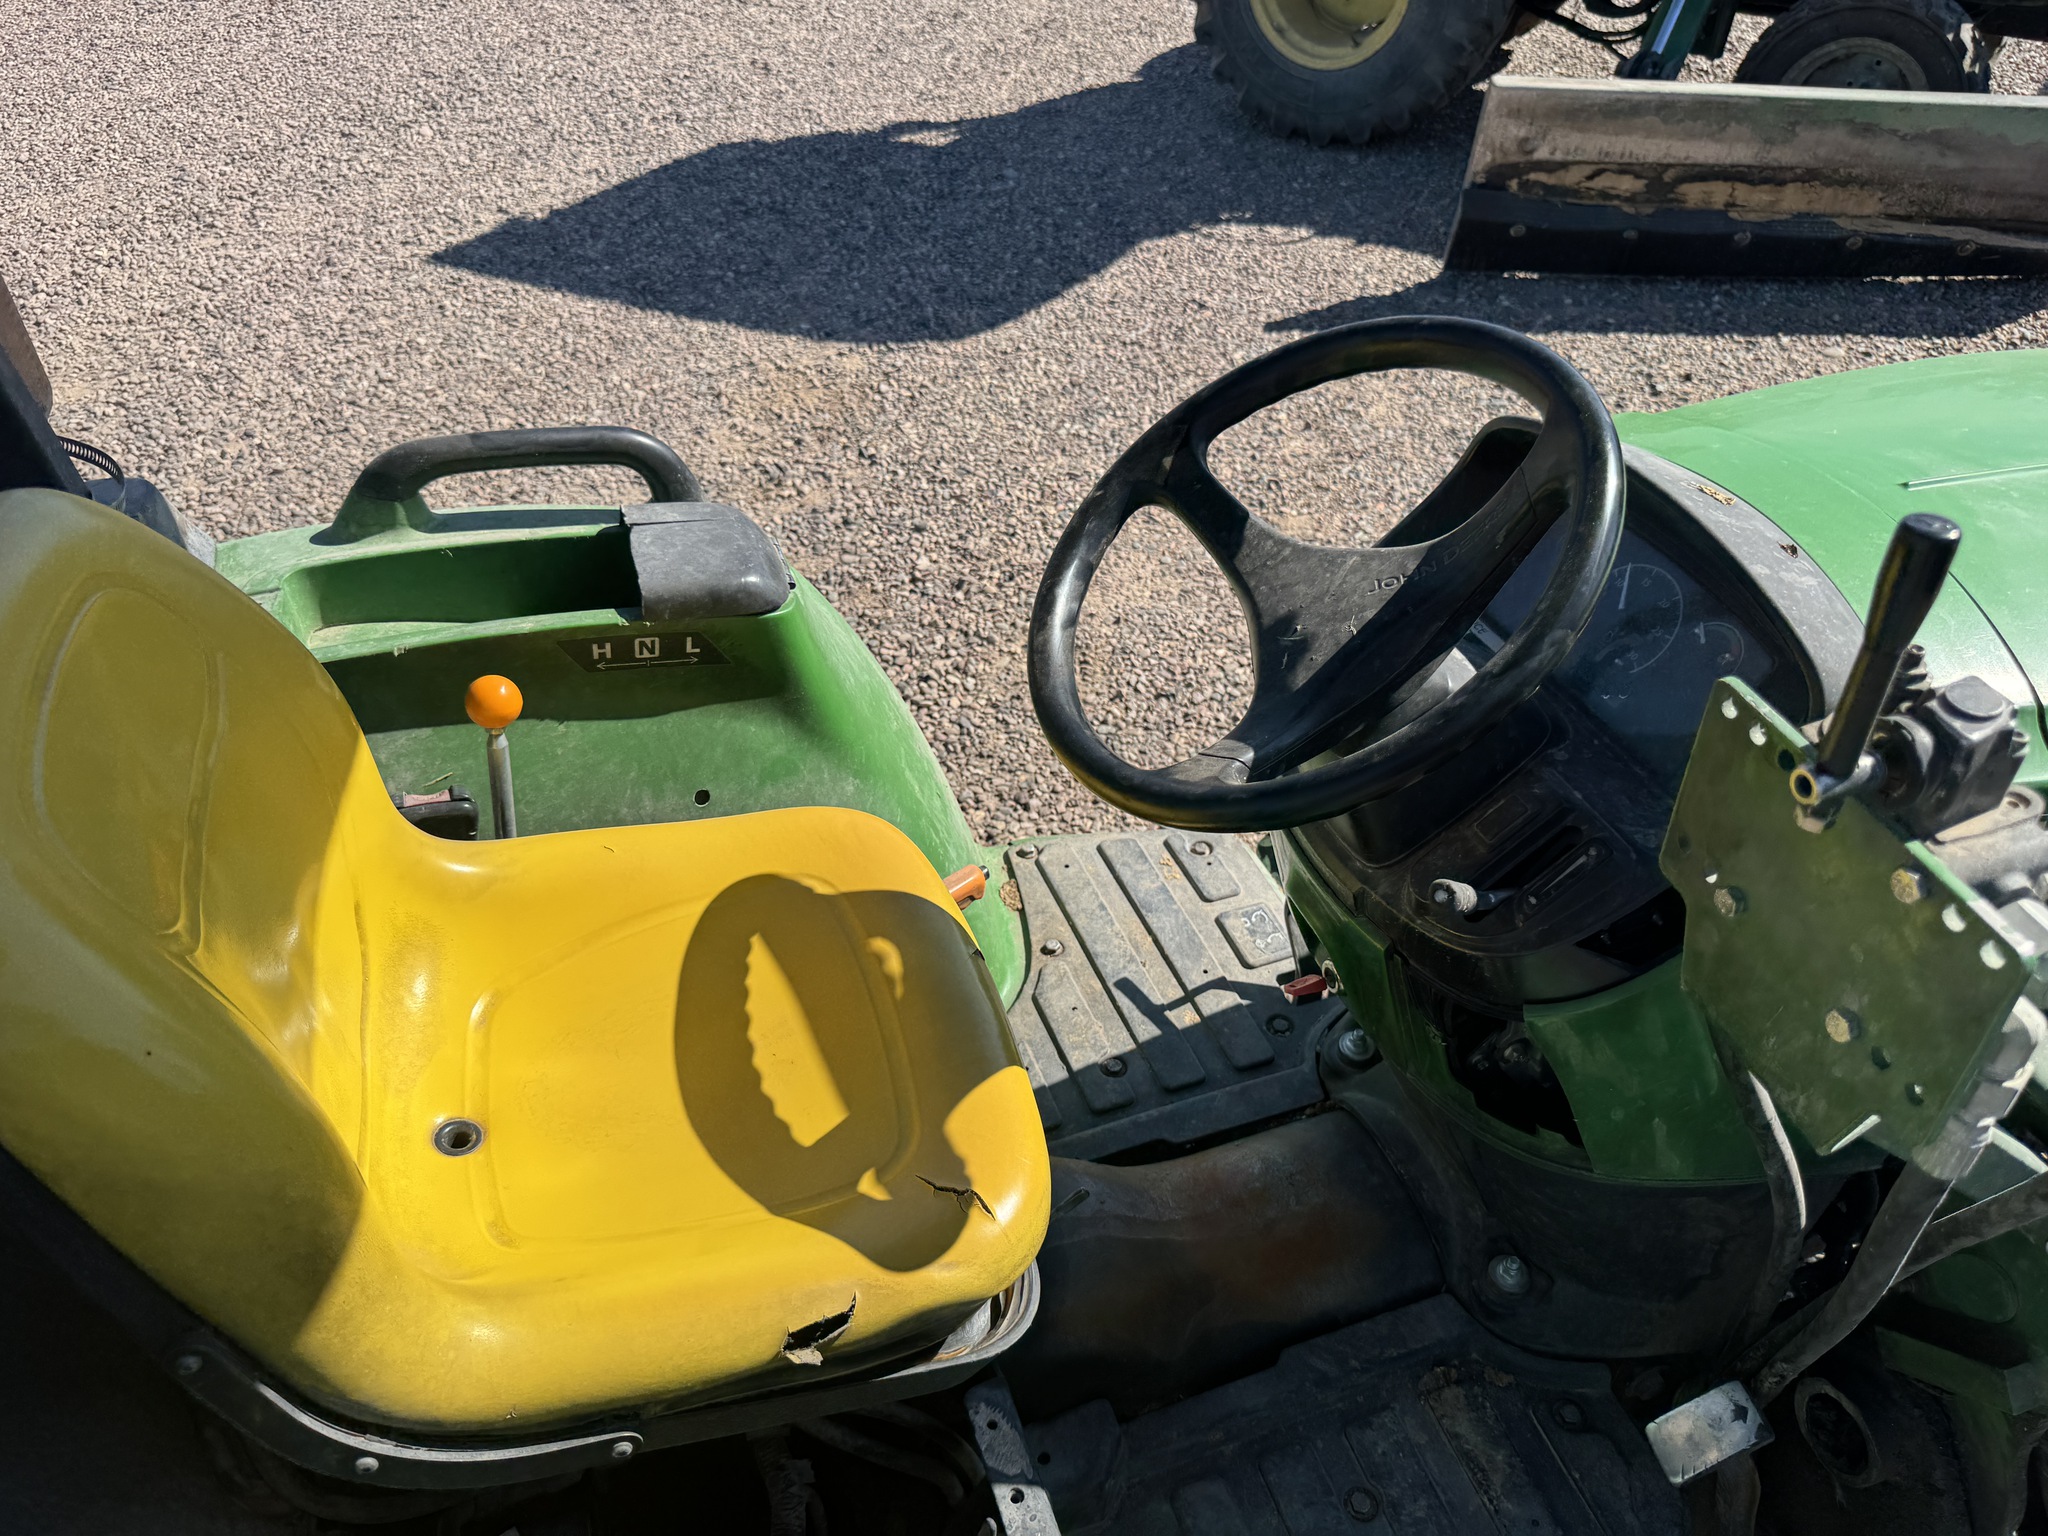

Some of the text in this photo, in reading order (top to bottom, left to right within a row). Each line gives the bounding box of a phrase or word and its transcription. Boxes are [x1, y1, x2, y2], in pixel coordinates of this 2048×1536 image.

[1365, 560, 1438, 597] JOHN
[592, 636, 701, 660] H N L
